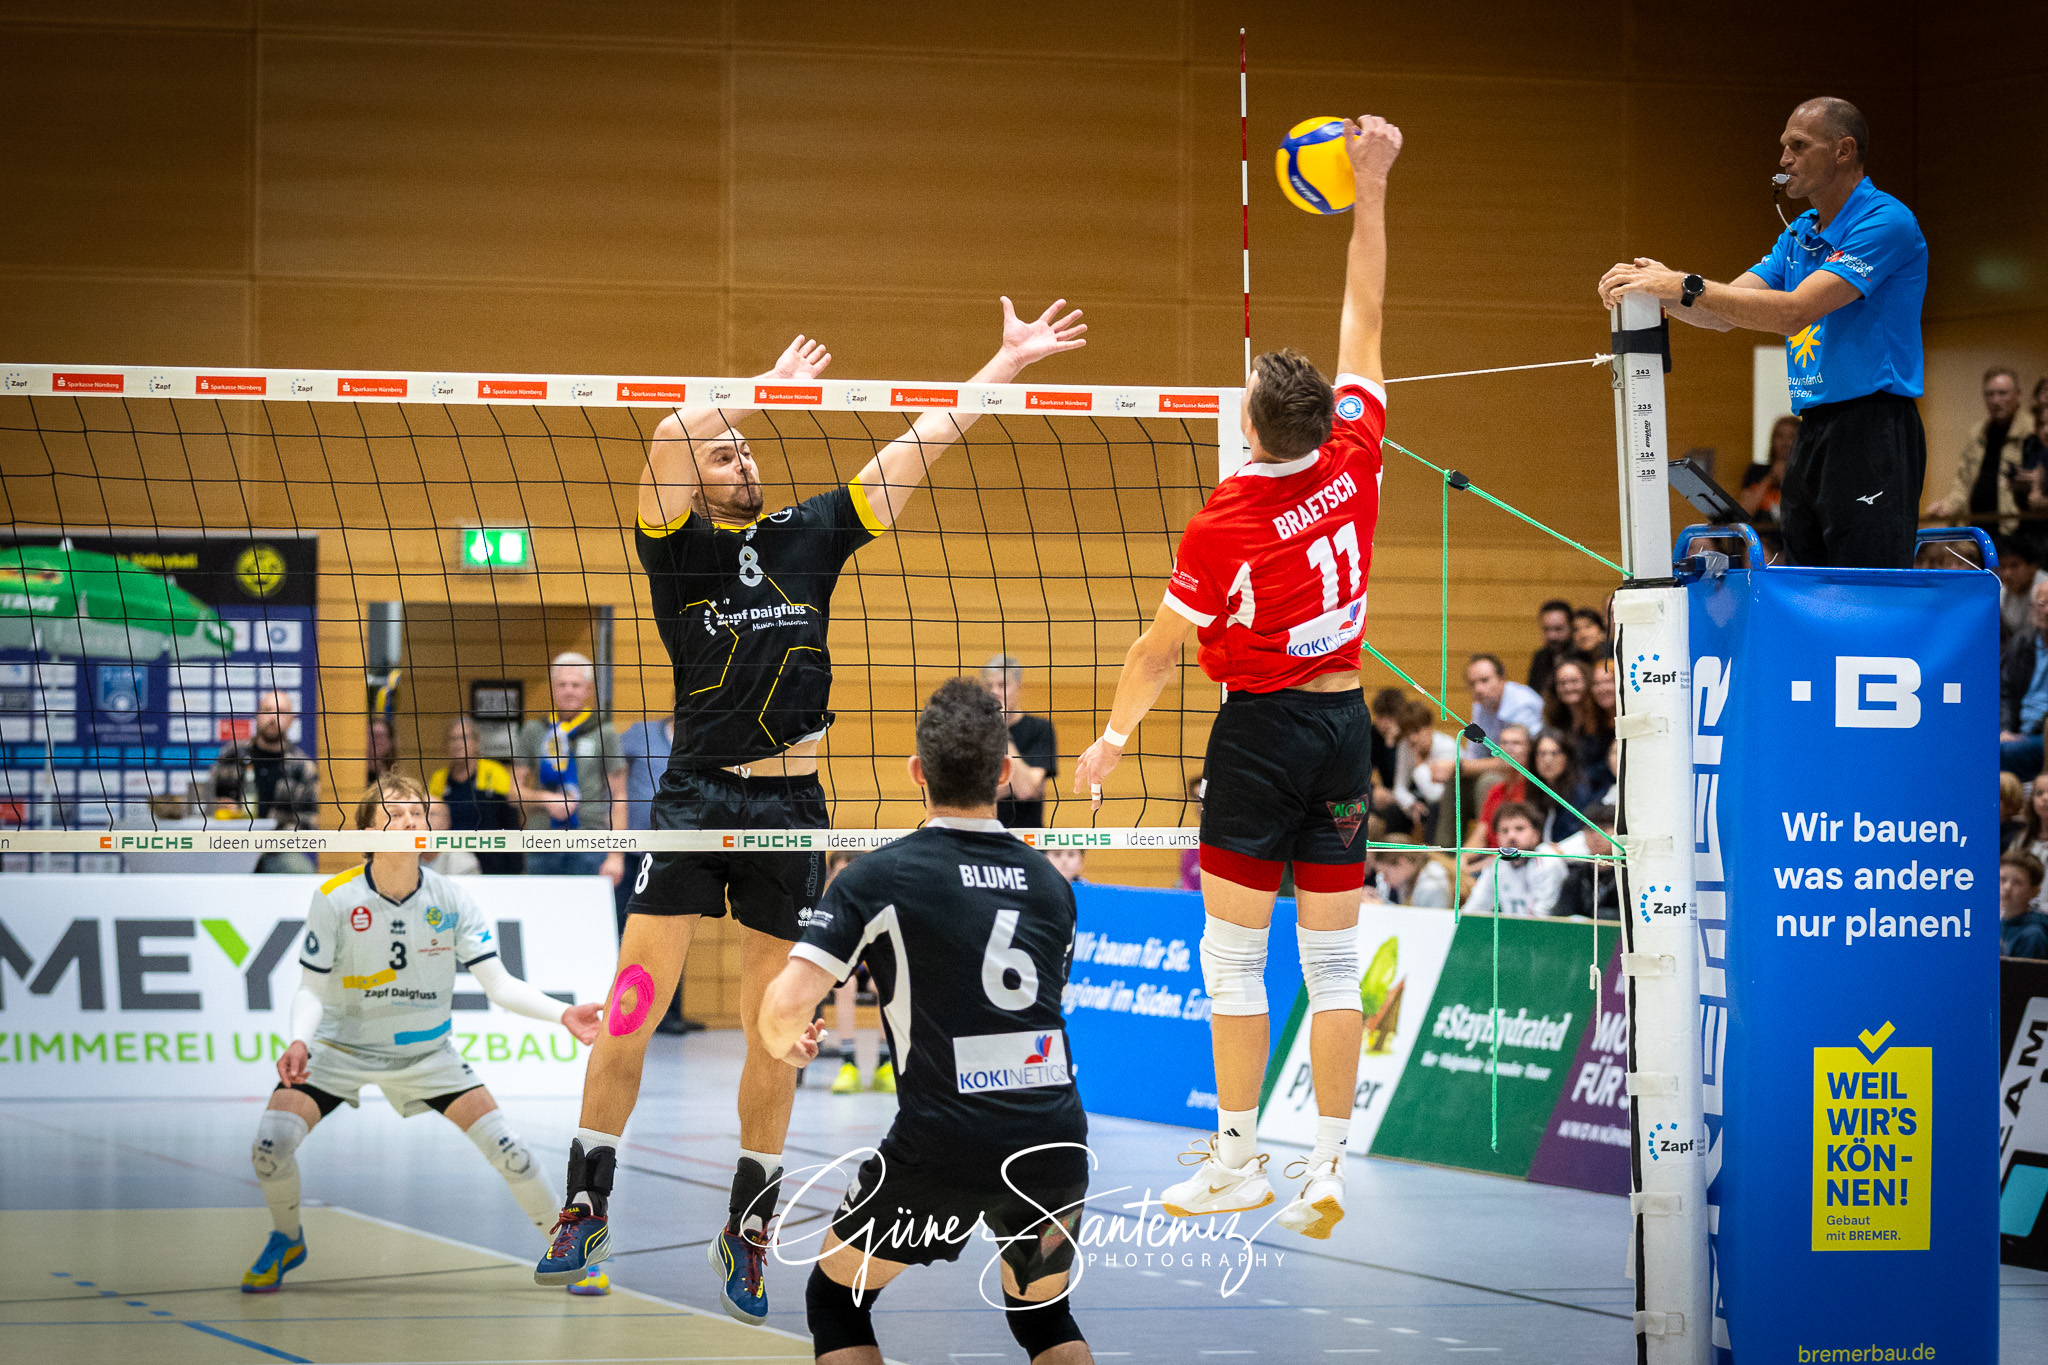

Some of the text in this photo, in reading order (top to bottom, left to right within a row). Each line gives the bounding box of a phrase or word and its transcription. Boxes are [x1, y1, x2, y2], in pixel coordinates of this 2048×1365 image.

[67, 381, 93, 389] Sparkasse
[155, 383, 171, 391] Zapf
[297, 385, 313, 393] Zapf
[492, 388, 517, 396] Sparkasse
[1789, 386, 1813, 398] eisen
[631, 390, 656, 398] Sparkasse
[1272, 472, 1358, 540] BRAETSCH
[739, 546, 763, 587] 8
[1306, 521, 1362, 613] 11
[750, 603, 806, 619] Daigfuss
[1642, 671, 1676, 685] Zapf
[1782, 812, 1968, 848] Wir bauen,
[121, 836, 326, 849] FUCHS Ideen umsetzen
[436, 835, 637, 849] FUCHS Ideen umsetzen
[743, 835, 812, 848] FUCHS
[827, 834, 865, 847] Ideen
[1044, 834, 1111, 846] FUCHS
[1126, 832, 1163, 846] Ideen
[635, 853, 653, 894] 8
[959, 865, 1028, 890] BLUME
[1774, 860, 1974, 890] was andere
[1653, 903, 1687, 916] Zapf
[1776, 908, 1971, 945] nur planen!
[389, 941, 407, 970] 3
[981, 909, 1039, 1011] 6
[365, 988, 389, 998] Zapf
[960, 1064, 1067, 1090] KOKINETICS
[1571, 1055, 1625, 1106] FÜR
[1826, 1072, 1908, 1100] WEIL
[1661, 1139, 1694, 1154] Zapf
[1826, 1179, 1908, 1206] NEN!
[1826, 1215, 1871, 1226] Gebaut
[1826, 1230, 1901, 1241] mit BREMER.
[1798, 1343, 1936, 1363] bremerbau.de
